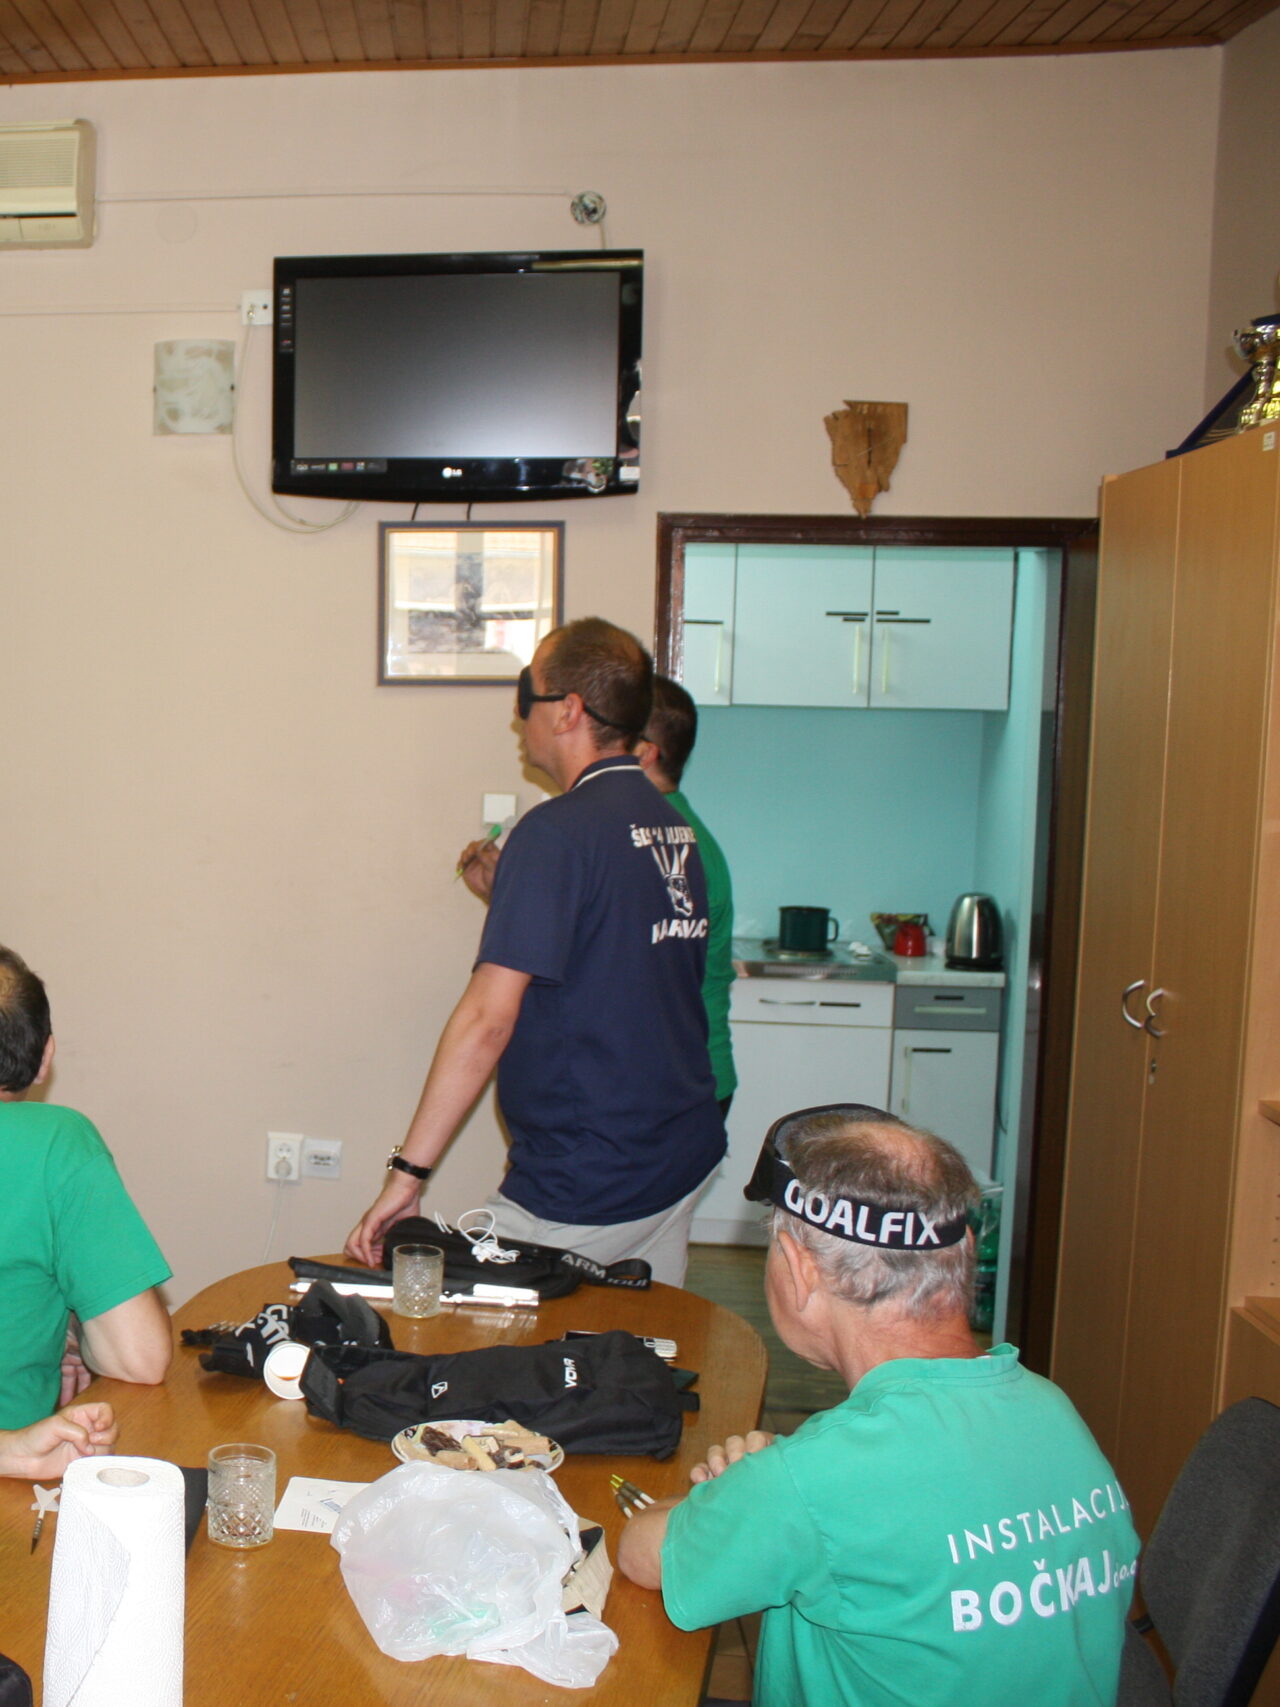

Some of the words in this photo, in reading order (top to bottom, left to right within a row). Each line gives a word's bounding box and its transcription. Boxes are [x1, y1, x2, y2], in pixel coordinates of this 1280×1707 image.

[784, 1178, 941, 1246] GOALFIX
[947, 1480, 1130, 1565] INSTALACIJ
[950, 1549, 1112, 1632] BOČKAJ
